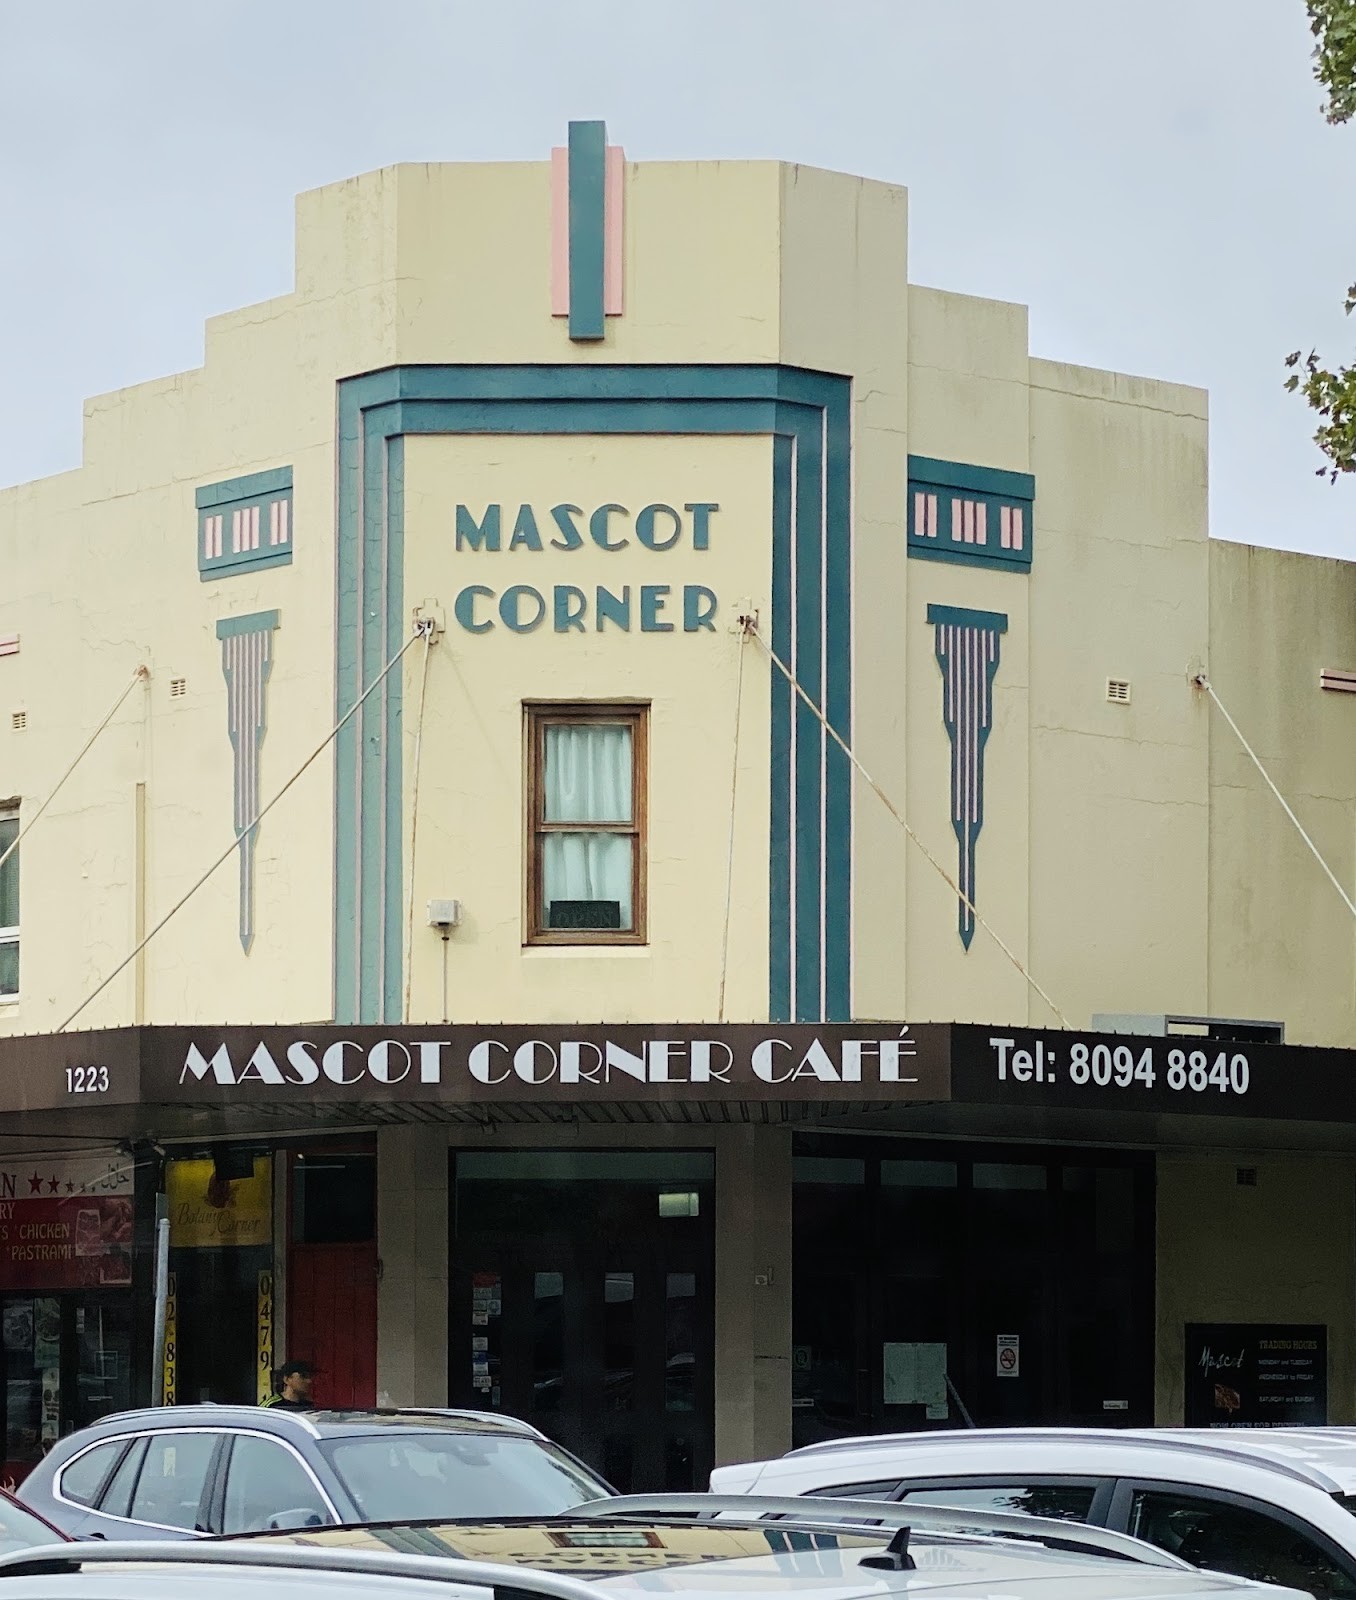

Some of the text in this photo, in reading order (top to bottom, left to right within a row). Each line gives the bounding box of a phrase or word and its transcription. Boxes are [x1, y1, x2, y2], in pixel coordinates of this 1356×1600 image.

[455, 503, 719, 551] MASCOT
[454, 585, 718, 634] CORNER
[179, 1025, 918, 1085] MASCOT CORNER CAFÉ
[989, 1037, 1250, 1095] Tel: 8094 8840
[65, 1066, 109, 1093] 1223
[19, 1222, 70, 1240] CHICKEN
[217, 1210, 261, 1234] Corner
[11, 1243, 72, 1261] PASTRAMI
